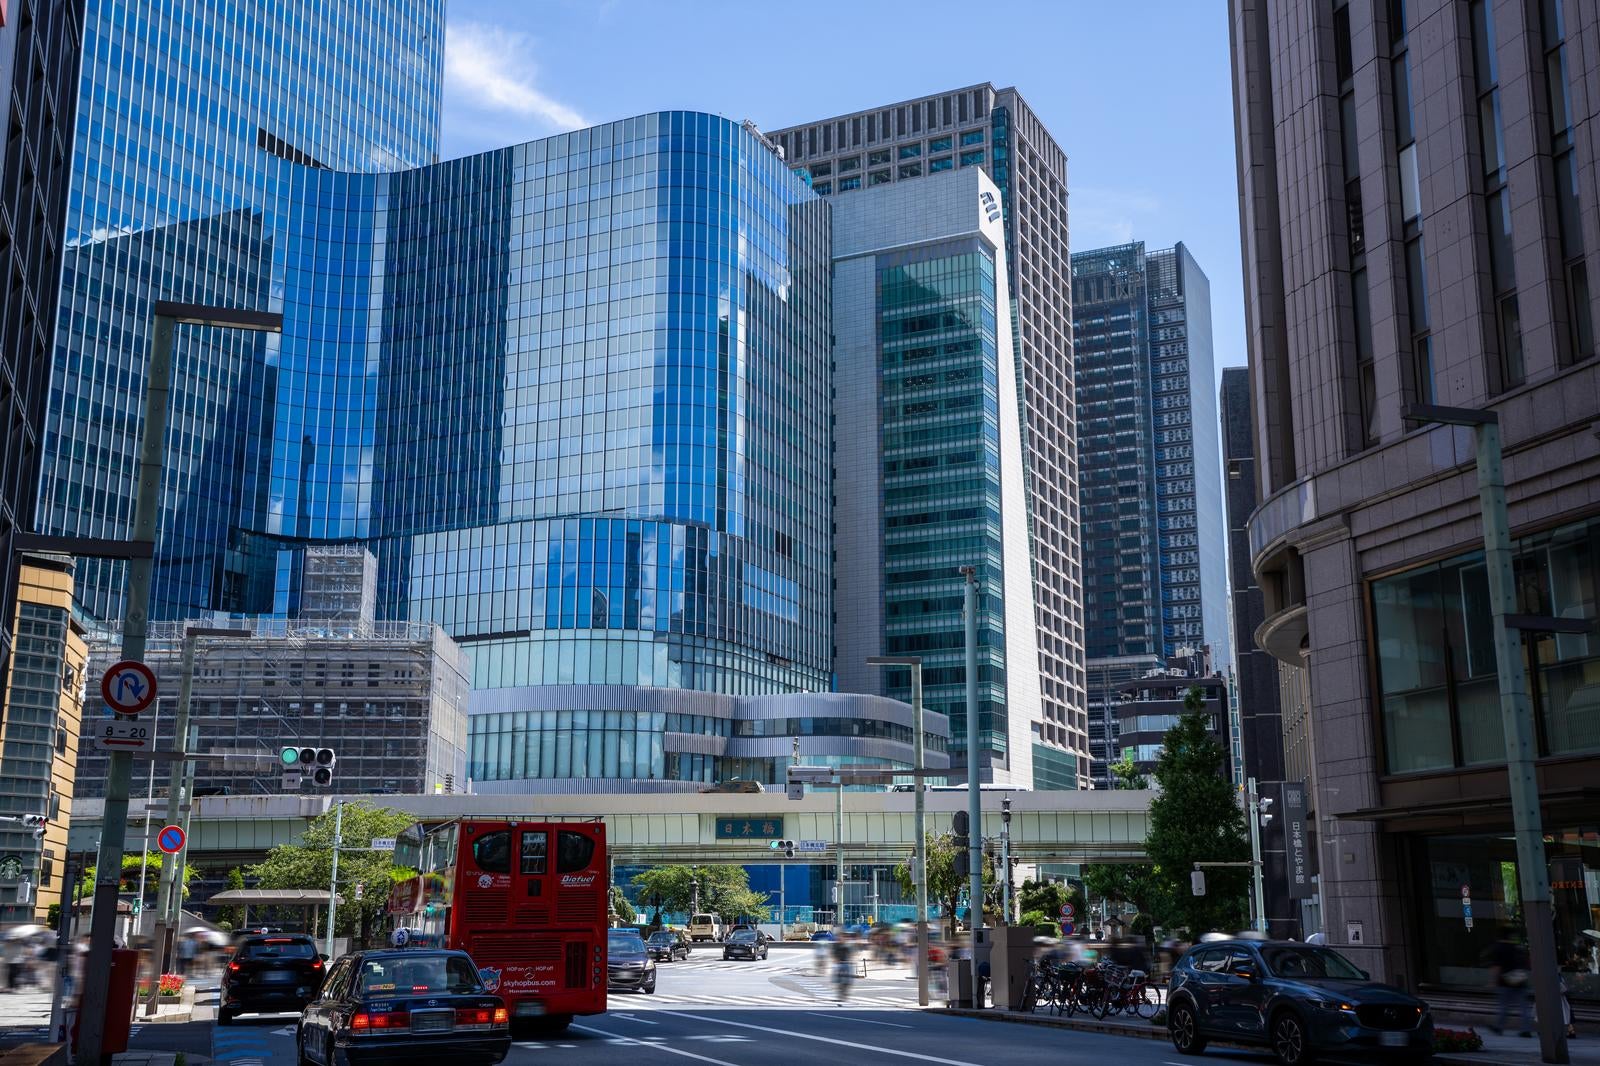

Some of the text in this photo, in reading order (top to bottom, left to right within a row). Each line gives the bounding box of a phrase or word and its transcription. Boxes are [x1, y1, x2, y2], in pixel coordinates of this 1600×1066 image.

[725, 822, 775, 834] 日本橋
[1292, 821, 1305, 884] 日本橋とやま館
